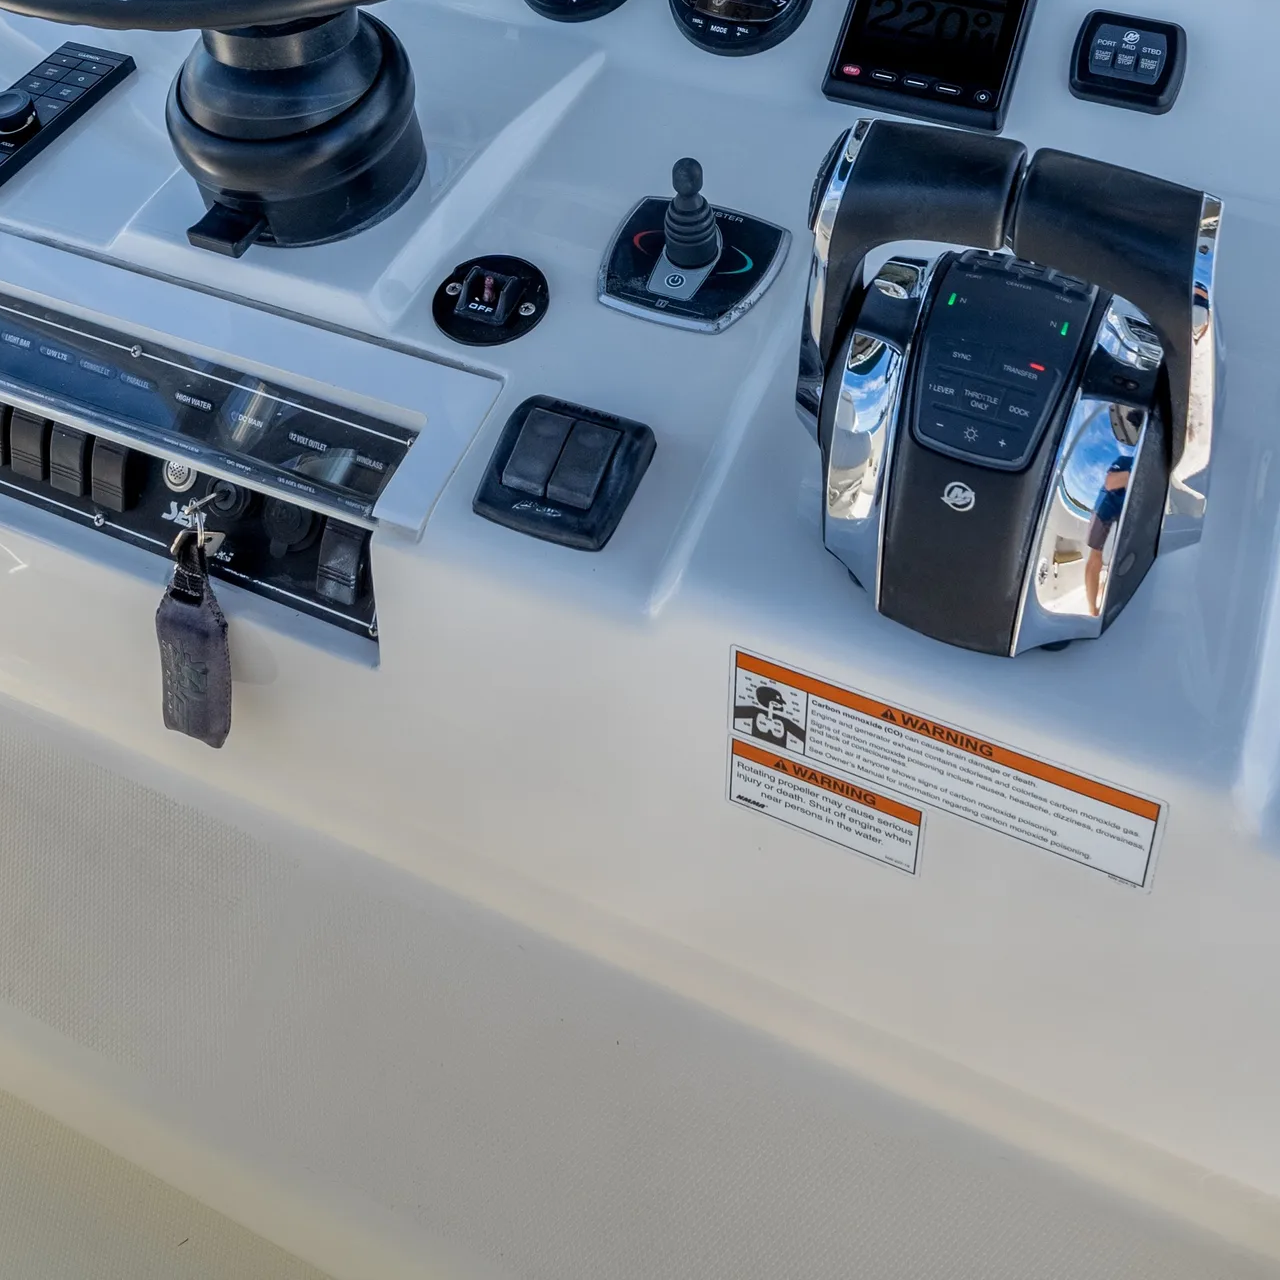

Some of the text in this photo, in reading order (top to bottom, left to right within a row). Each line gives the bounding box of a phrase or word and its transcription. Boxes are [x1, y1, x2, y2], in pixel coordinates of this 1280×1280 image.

[777, 0, 787, 8] 7
[710, 24, 728, 35] MODE
[1097, 38, 1117, 47] PORT
[1121, 43, 1136, 51] MID
[78, 52, 100, 61] GARMIN
[1142, 46, 1162, 56] STBD
[1005, 280, 1032, 291] CENTER
[468, 302, 494, 314] OFF
[1050, 320, 1058, 328] N
[5, 334, 31, 348] LIGHT BAR
[58, 353, 68, 361] LTS
[952, 351, 972, 361] SYNC
[1003, 364, 1038, 381] TRANSFER
[126, 375, 149, 389] PARALLEL
[933, 384, 955, 396] LEVER
[964, 388, 999, 405] THROTTLE
[176, 392, 212, 411] HIGH WATER
[970, 400, 989, 411] ONLY
[1008, 405, 1030, 418] DOCK
[238, 414, 263, 429] DC MAIN
[296, 434, 308, 446] VOLT
[308, 439, 328, 452] OUTLET
[356, 455, 383, 471] WINDLASS
[901, 713, 993, 757] WARNING
[809, 726, 907, 768] and lack of consciousness.
[811, 698, 1037, 789] Carbon monoxide (CO) can cause brain damage or death.
[810, 709, 1140, 839] Engine and generator exhaust contains odorless and colorless carbon monoxide gas.
[791, 764, 876, 806] WARNING
[809, 735, 823, 746] Get
[824, 741, 843, 754] fresh
[844, 749, 854, 758] air
[862, 757, 890, 773] anyone
[891, 767, 916, 782] shows
[917, 777, 937, 791] signs
[939, 785, 948, 794] of
[949, 789, 976, 805] carbon
[978, 800, 1016, 820] monoxide
[1017, 815, 1059, 838] poisoning.
[810, 719, 1146, 851] Signs of carbon monoxide poisoning include nausea, headache, dizziness, drowsiness,
[737, 760, 913, 837] Rotating propeller may cause serious
[808, 745, 1092, 861] See Owner's Manual for information regarding carbon monoxide poisoning.
[736, 770, 911, 846] injury or death. Shut off engine when
[760, 792, 884, 846] near persons in the water.
